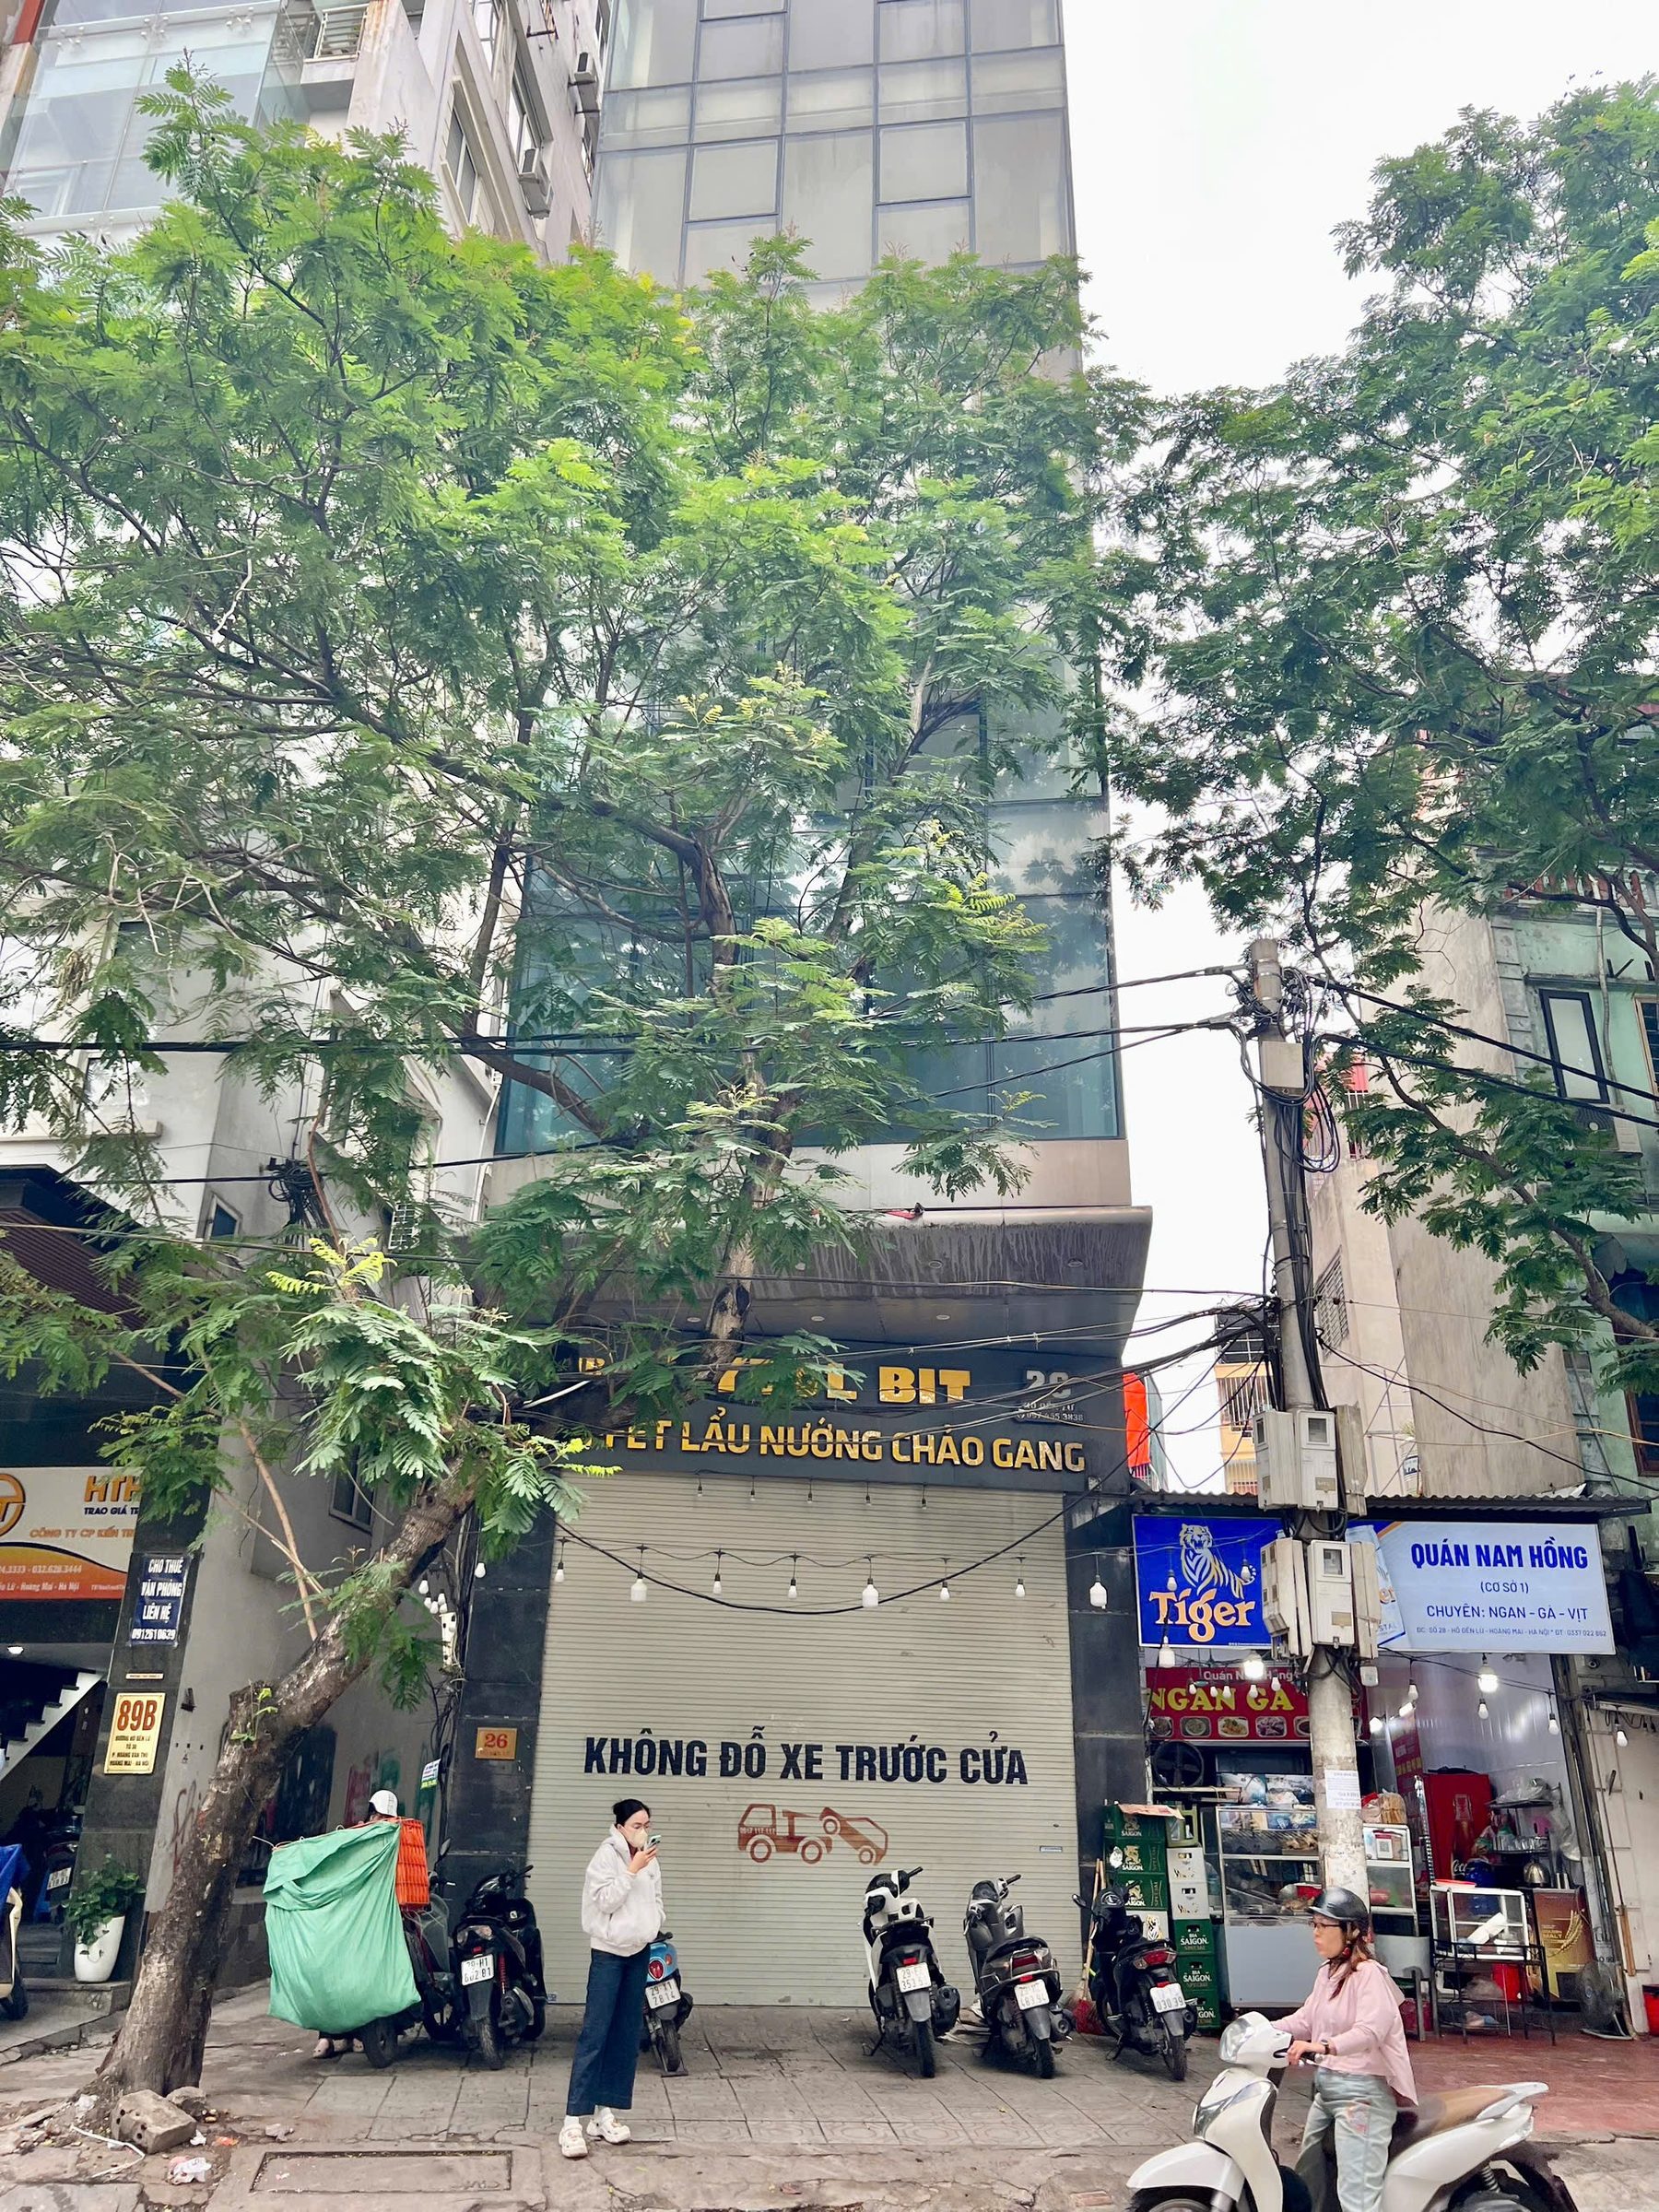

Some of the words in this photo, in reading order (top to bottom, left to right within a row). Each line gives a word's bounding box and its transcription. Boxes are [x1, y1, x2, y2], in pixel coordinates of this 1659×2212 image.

[879, 1366, 971, 1404] BIT
[681, 1406, 750, 1454] LẨU
[759, 1417, 882, 1461] NƯỚNG
[993, 1438, 1085, 1472] GANG
[65, 1529, 77, 1538] TY
[80, 1529, 96, 1538] CP
[1411, 1538, 1470, 1569] QUÁN
[1476, 1544, 1524, 1567] NAM
[1529, 1536, 1589, 1569] HỒNG
[148, 1559, 163, 1573] CHO
[1149, 1588, 1256, 1642] Tiger
[1427, 1603, 1485, 1618] CHUYÊN:
[1489, 1606, 1526, 1619] NGAN
[1537, 1605, 1556, 1619] GÀ
[1568, 1607, 1589, 1623] VỊT
[1204, 1670, 1233, 1681] Quán
[117, 1700, 158, 1731] 89B
[485, 1734, 508, 1748] 26
[584, 1728, 707, 1775] KHÔNG
[720, 1725, 766, 1779] ĐỖ
[780, 1743, 823, 1781] XE
[836, 1735, 947, 1783] TRƯỚC
[960, 1730, 1029, 1785] CỬA
[1181, 1936, 1209, 1945] SAIGON
[1182, 1973, 1212, 1983] SAIGON
[1198, 2009, 1216, 2018] GON
